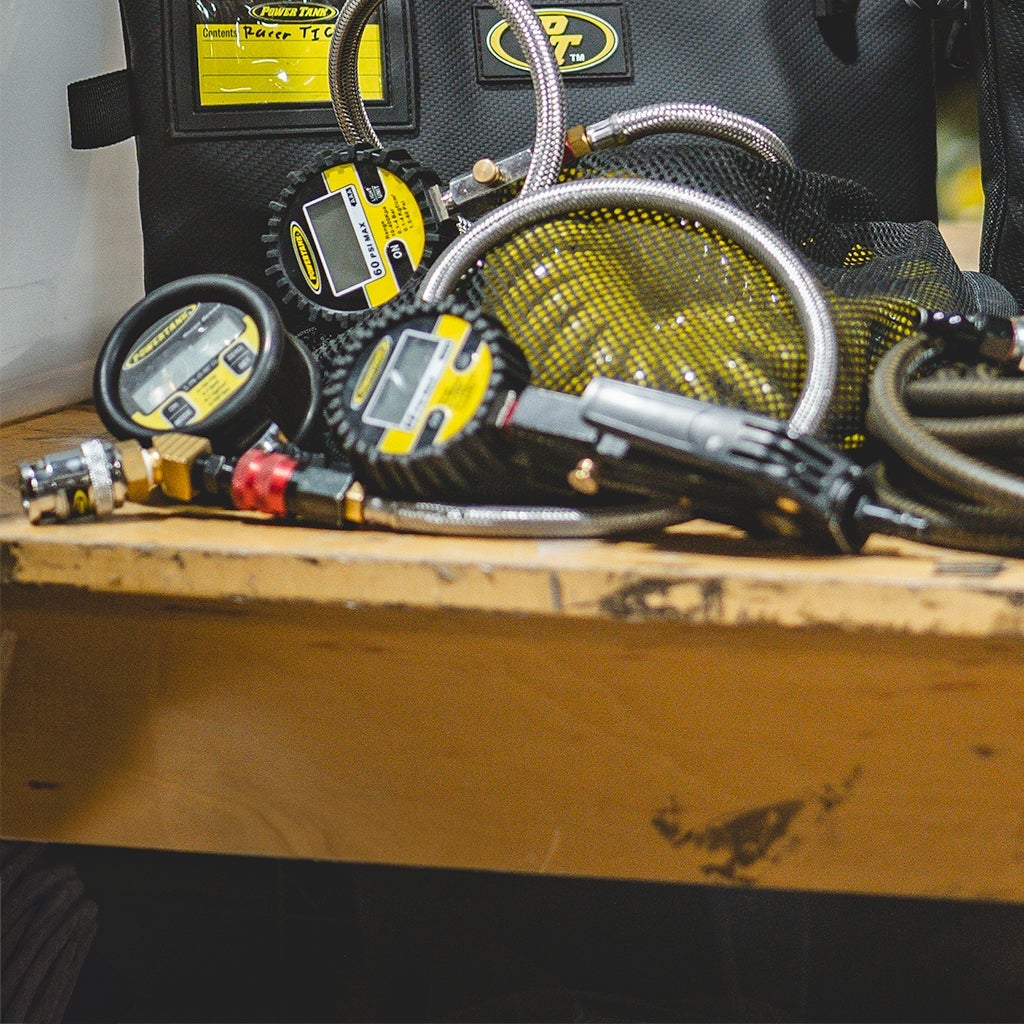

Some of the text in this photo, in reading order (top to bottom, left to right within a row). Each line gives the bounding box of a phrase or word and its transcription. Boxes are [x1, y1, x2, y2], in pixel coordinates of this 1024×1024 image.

[358, 221, 382, 276] 60 PSI MAX
[389, 243, 403, 259] ON
